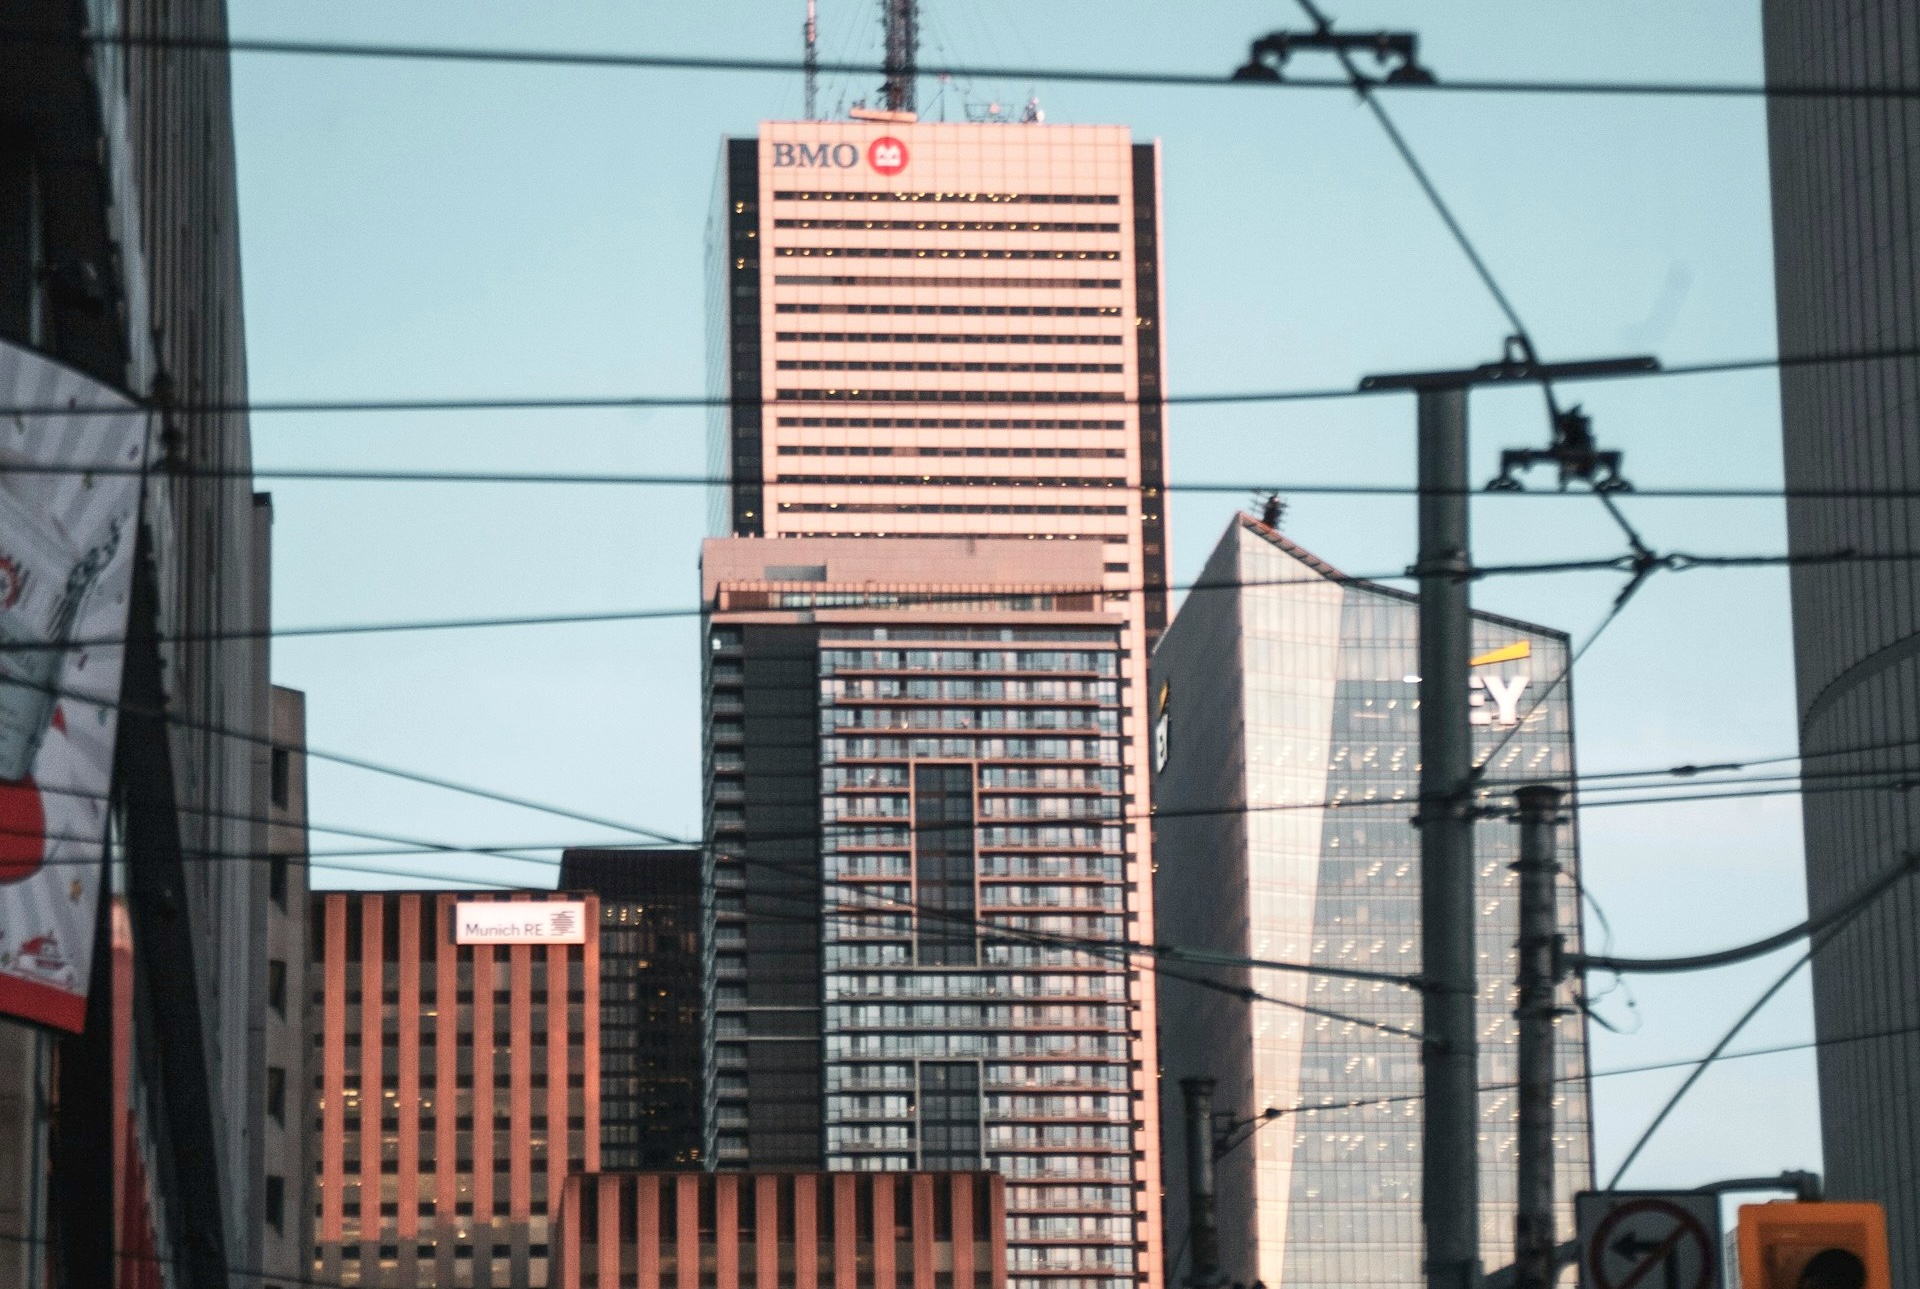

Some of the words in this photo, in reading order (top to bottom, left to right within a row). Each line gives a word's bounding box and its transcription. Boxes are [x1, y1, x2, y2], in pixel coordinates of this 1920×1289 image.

[773, 143, 859, 168] BMO
[465, 923, 521, 937] Munich
[524, 923, 545, 936] RE
